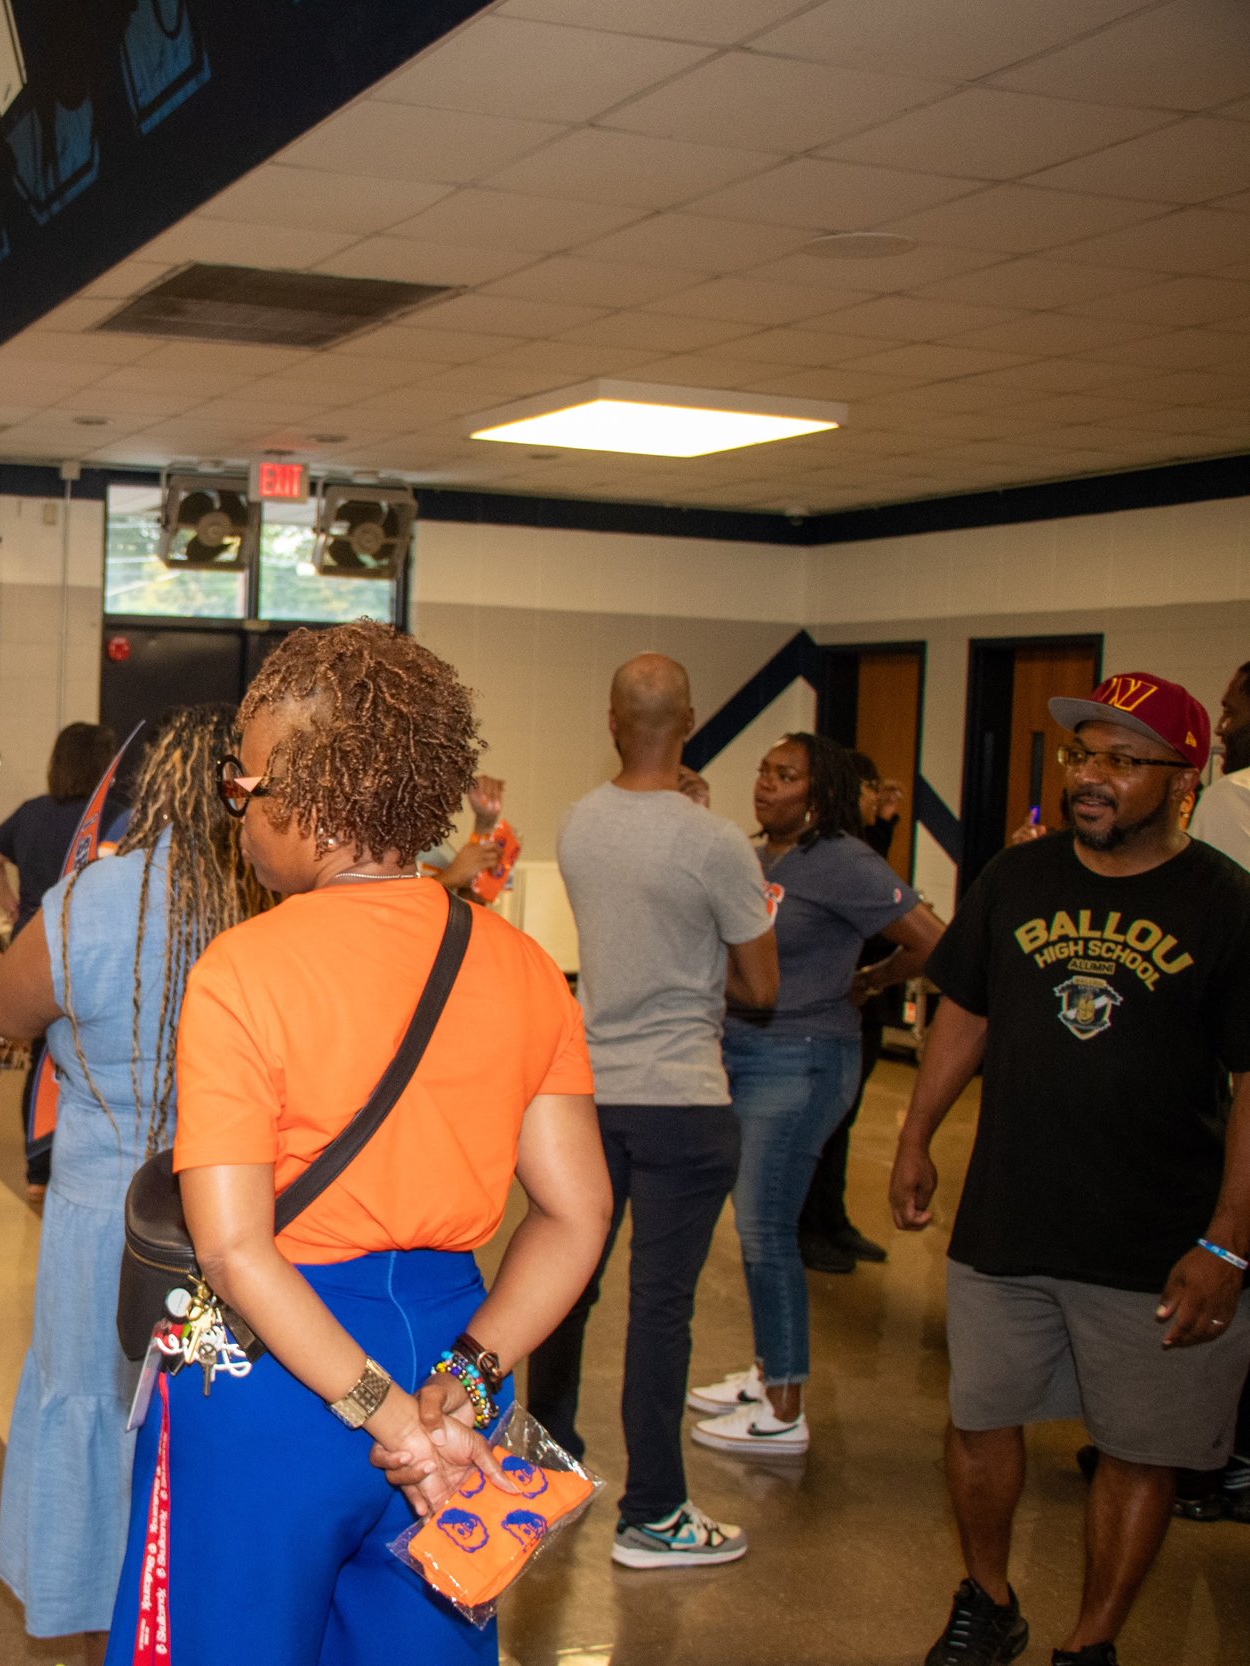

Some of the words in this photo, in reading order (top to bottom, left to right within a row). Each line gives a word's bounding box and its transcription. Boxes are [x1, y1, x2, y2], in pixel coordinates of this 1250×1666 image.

[260, 463, 302, 498] EXIT
[1014, 909, 1194, 974] BALLOU
[1034, 940, 1084, 969] HIGH
[1088, 940, 1160, 991] SCHOOL
